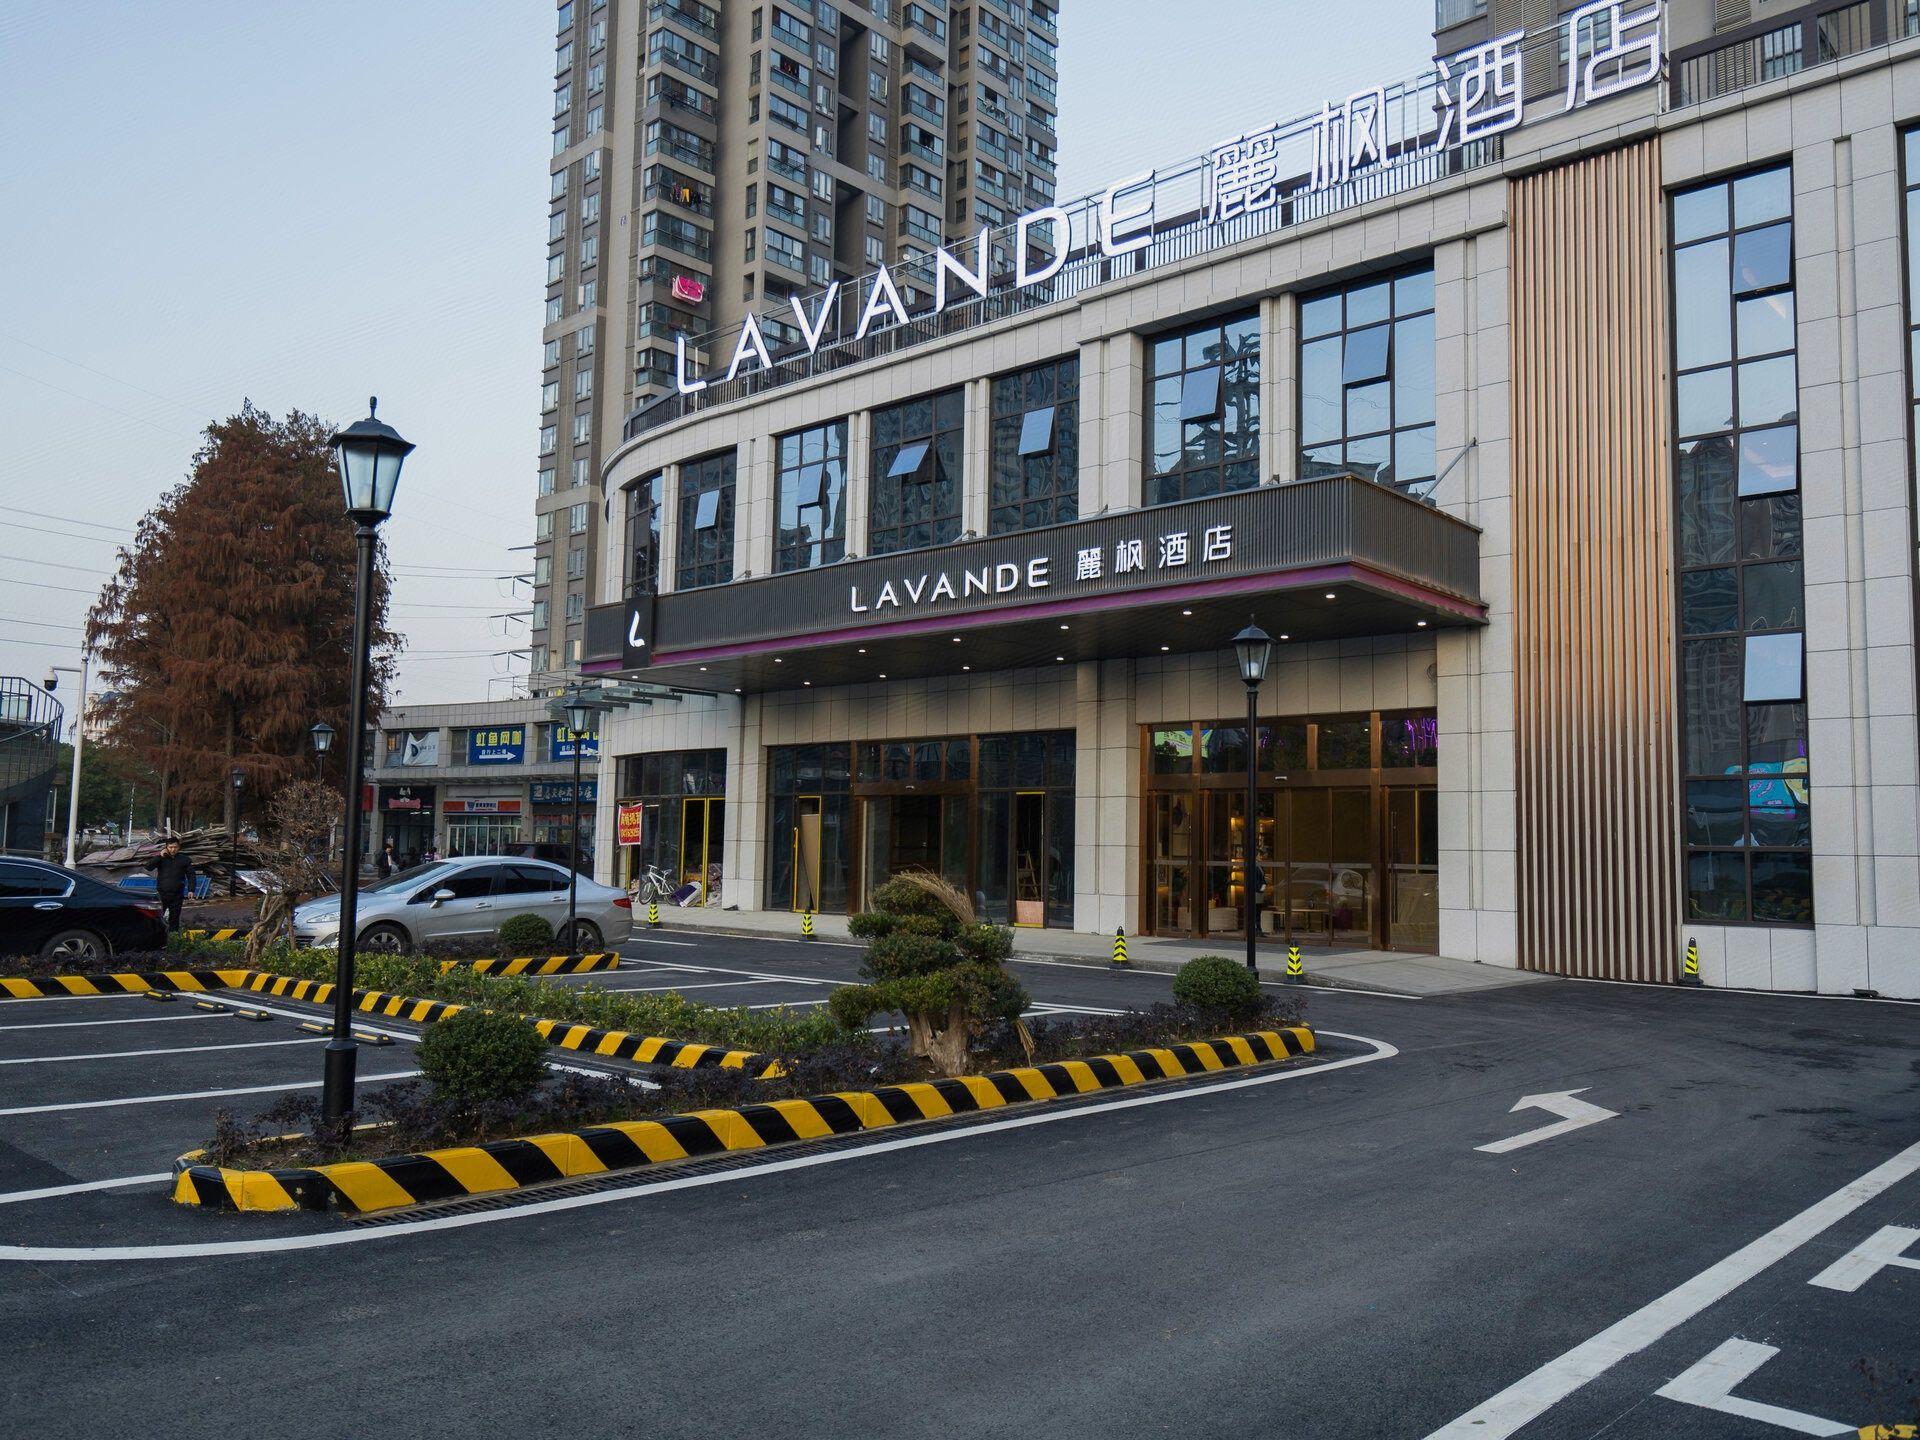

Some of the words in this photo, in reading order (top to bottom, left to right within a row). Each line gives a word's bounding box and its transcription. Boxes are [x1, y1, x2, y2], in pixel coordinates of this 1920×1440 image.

[675, 169, 1154, 394] LAVANDE
[1208, 0, 1661, 226] 麗枫酒店
[851, 556, 1050, 613] LAVANDE
[1075, 524, 1233, 582] 麗枫酒店
[475, 730, 522, 747] 虹鱼网咖
